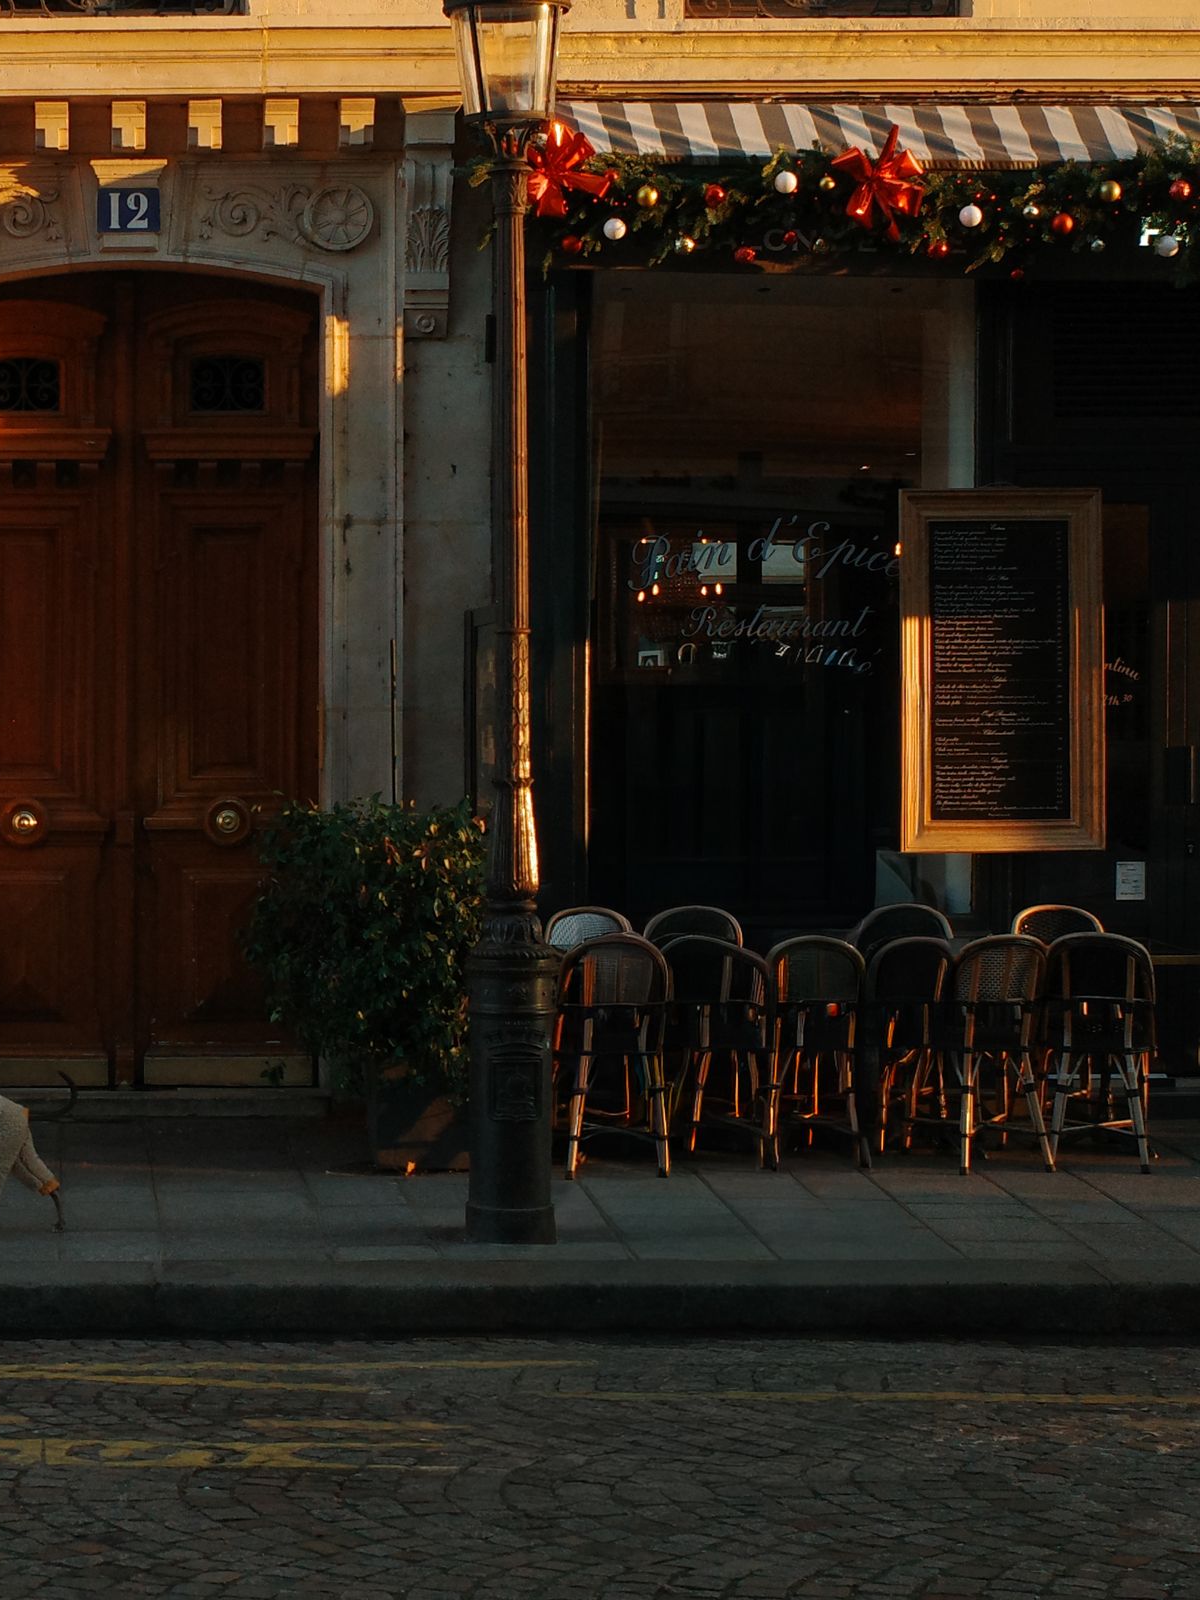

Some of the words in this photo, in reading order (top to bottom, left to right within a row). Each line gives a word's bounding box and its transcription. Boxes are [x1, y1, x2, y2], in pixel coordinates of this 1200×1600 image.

[108, 192, 149, 229] 12
[627, 528, 732, 592] Pain
[681, 602, 878, 640] Restaurant
